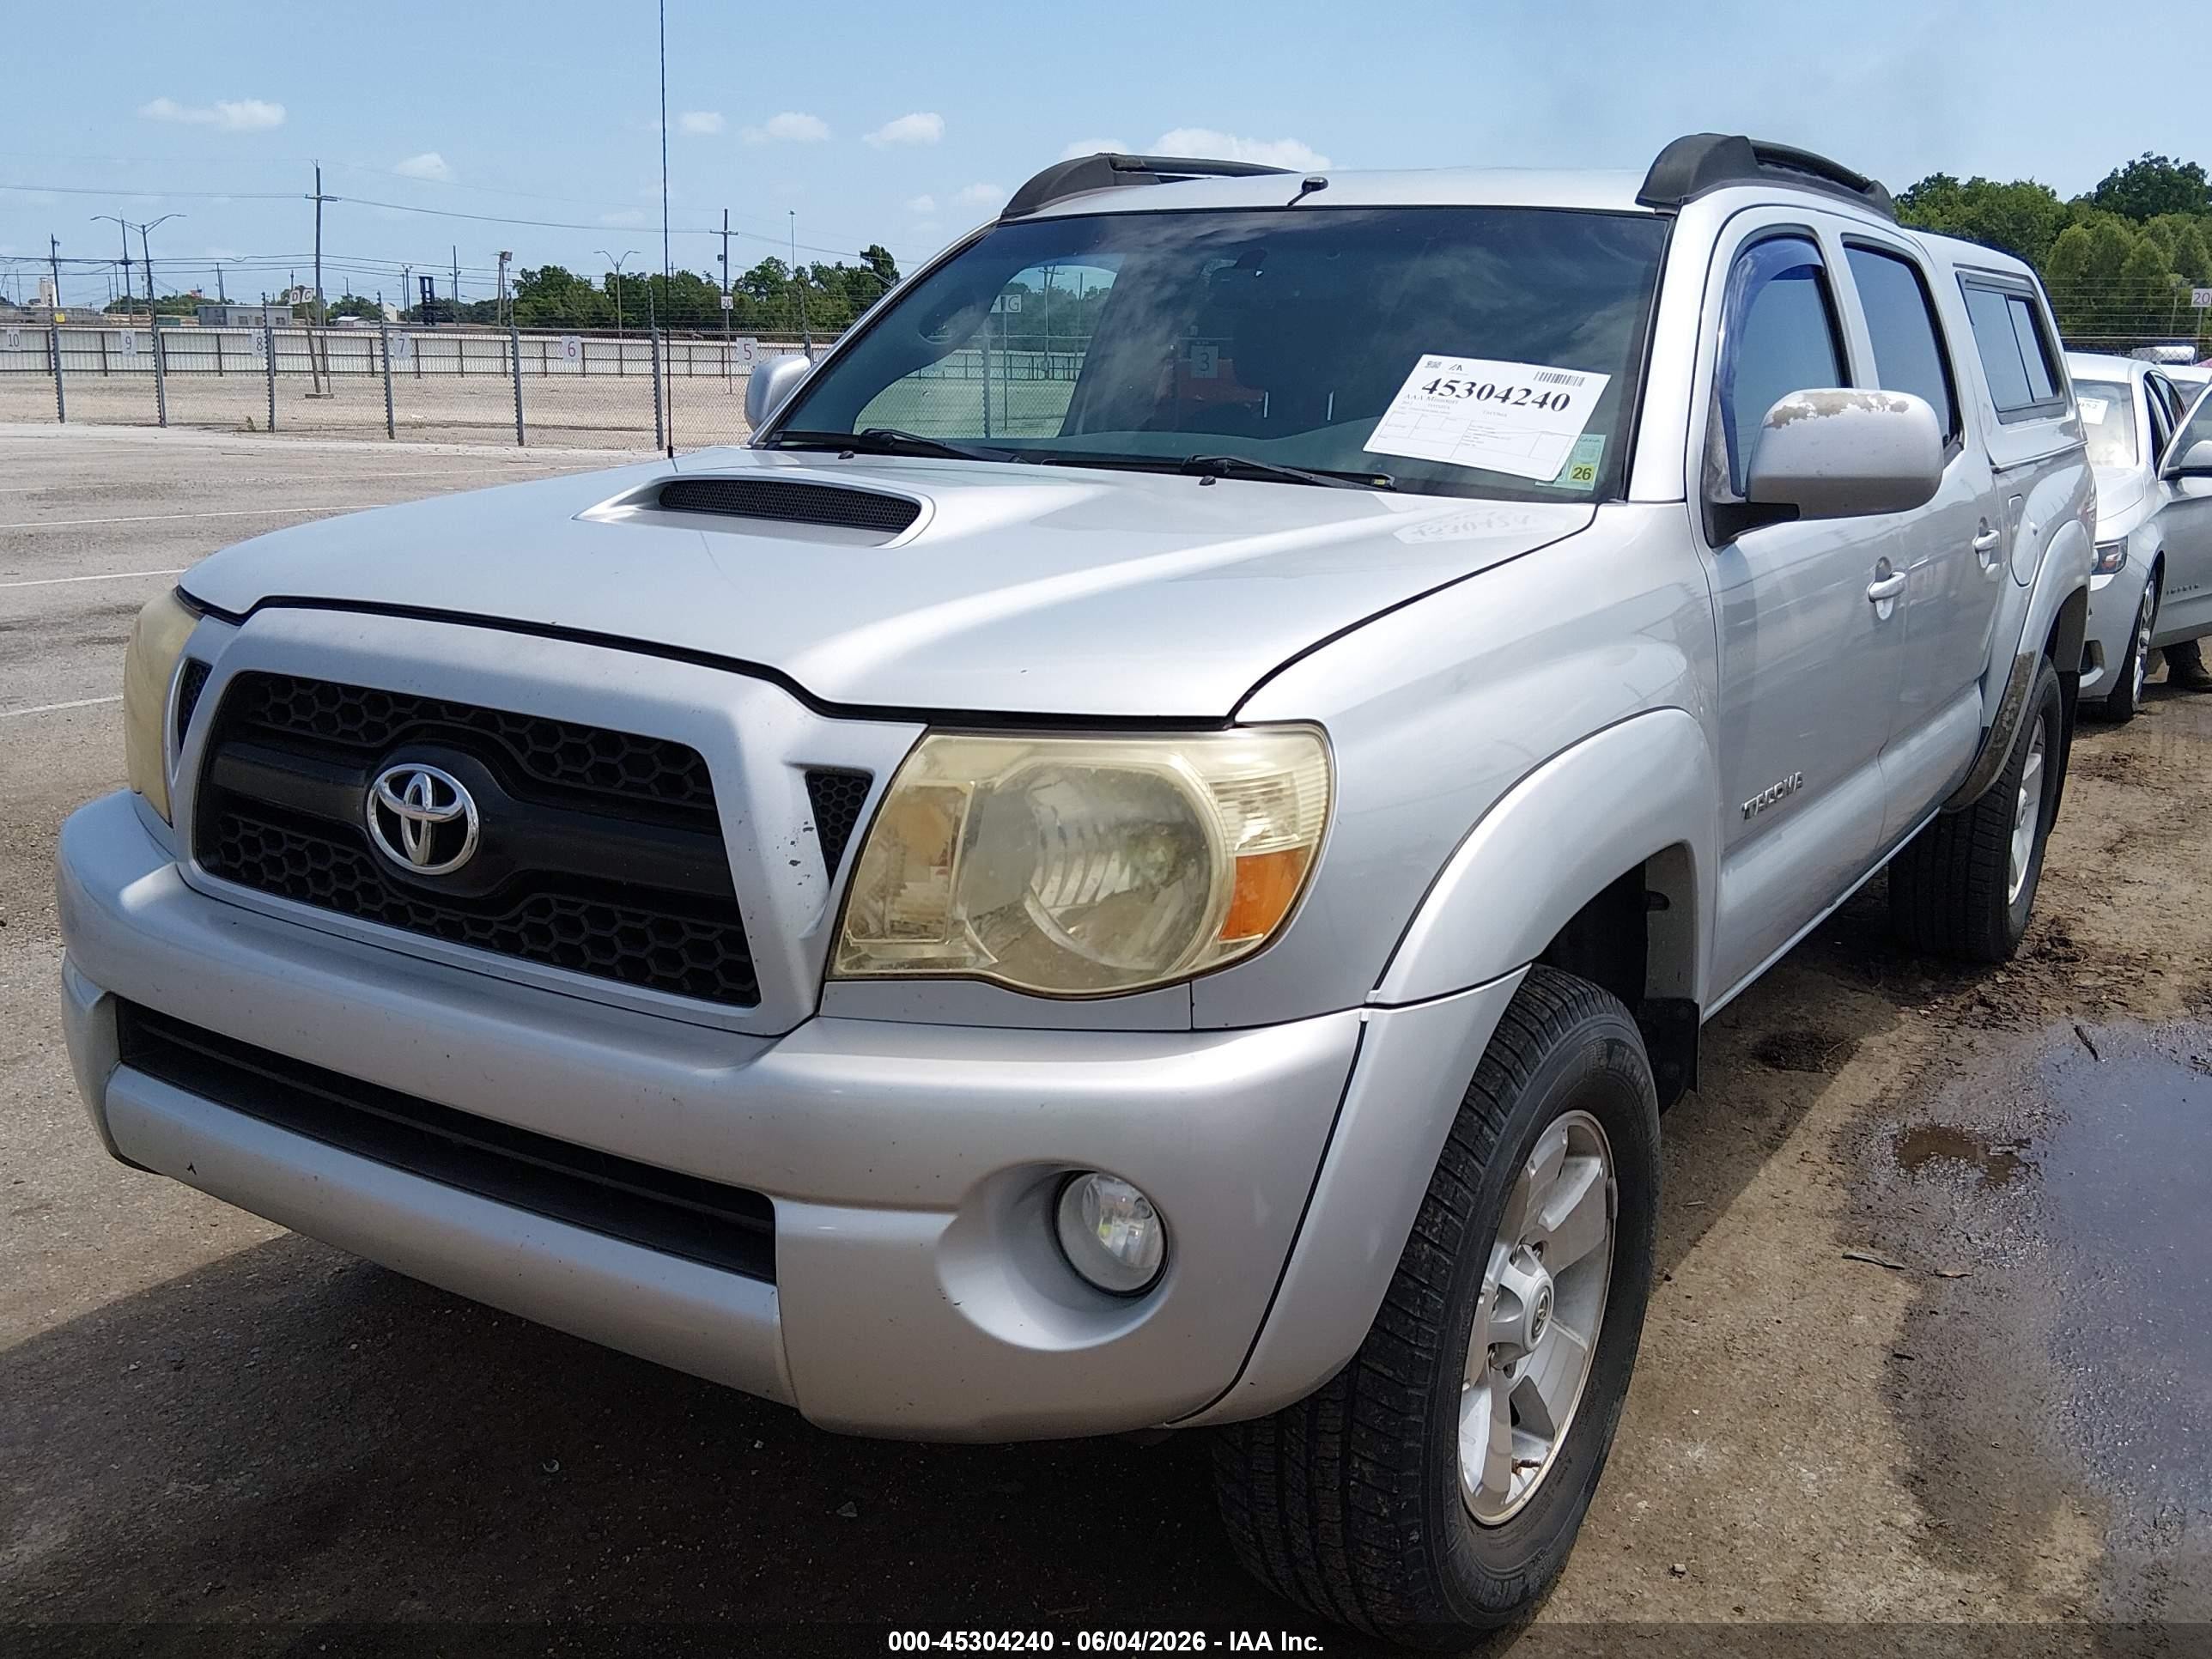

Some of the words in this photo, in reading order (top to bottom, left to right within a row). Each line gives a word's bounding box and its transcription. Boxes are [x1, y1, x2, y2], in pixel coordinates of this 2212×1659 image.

[292, 292, 299, 301] D
[304, 291, 312, 301] C
[723, 298, 732, 307] 20
[1008, 295, 1019, 311] G
[2193, 292, 2212, 303] 20
[9, 334, 20, 347] 10
[125, 336, 131, 349] 9
[257, 337, 263, 351] 8
[398, 337, 404, 353] 7
[568, 341, 576, 357] 6
[744, 343, 752, 360] 5
[1200, 352, 1209, 371] 3
[1421, 377, 1571, 412] 45304240
[1572, 466, 1592, 480] 26
